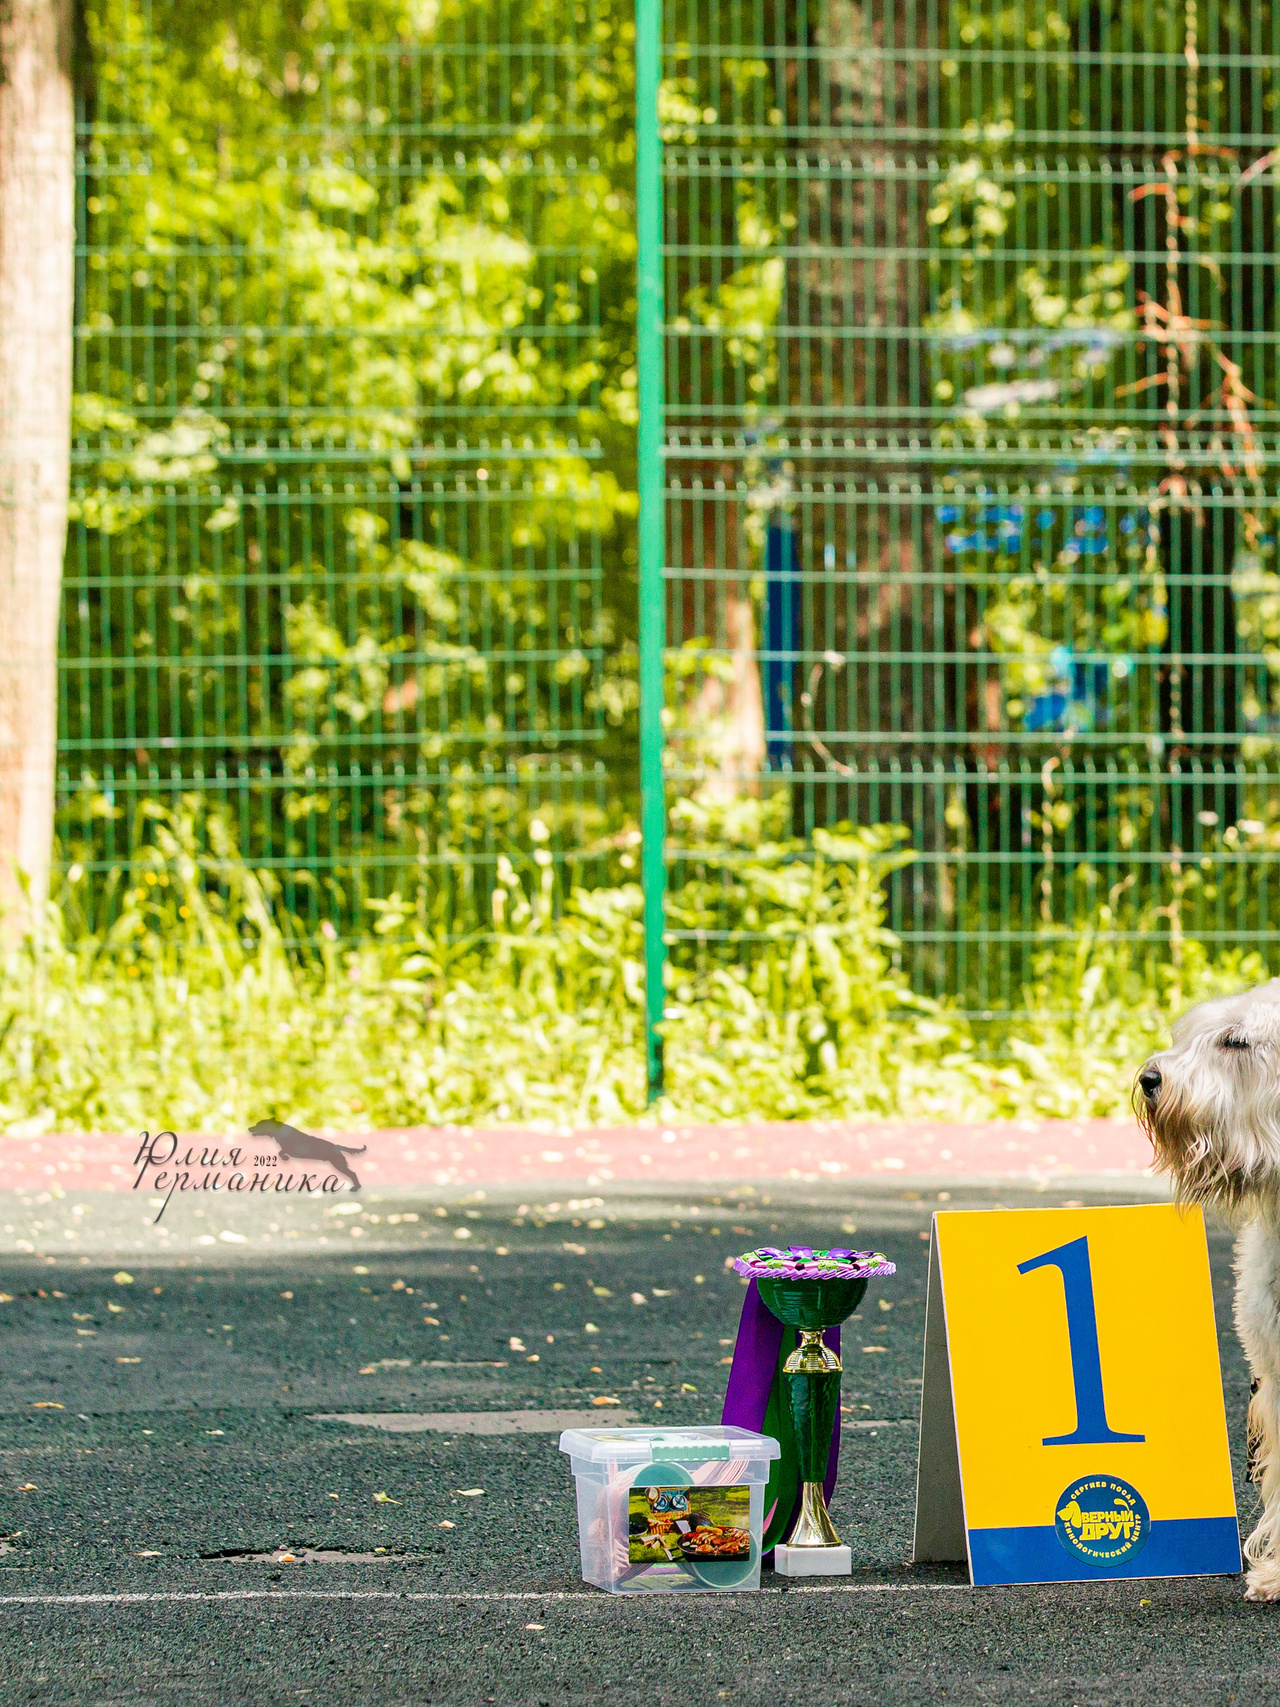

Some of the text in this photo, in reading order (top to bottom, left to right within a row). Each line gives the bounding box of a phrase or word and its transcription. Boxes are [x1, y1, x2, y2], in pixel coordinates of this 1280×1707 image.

[1016, 1234, 1146, 1447] 1
[1070, 1481, 1137, 1506] СЕРГИЕВ ПОСАД
[1064, 1513, 1142, 1558] КИНОЛОГИЧЕСКИЙ ЦЕНТР
[1079, 1521, 1135, 1541] ДРУГ
